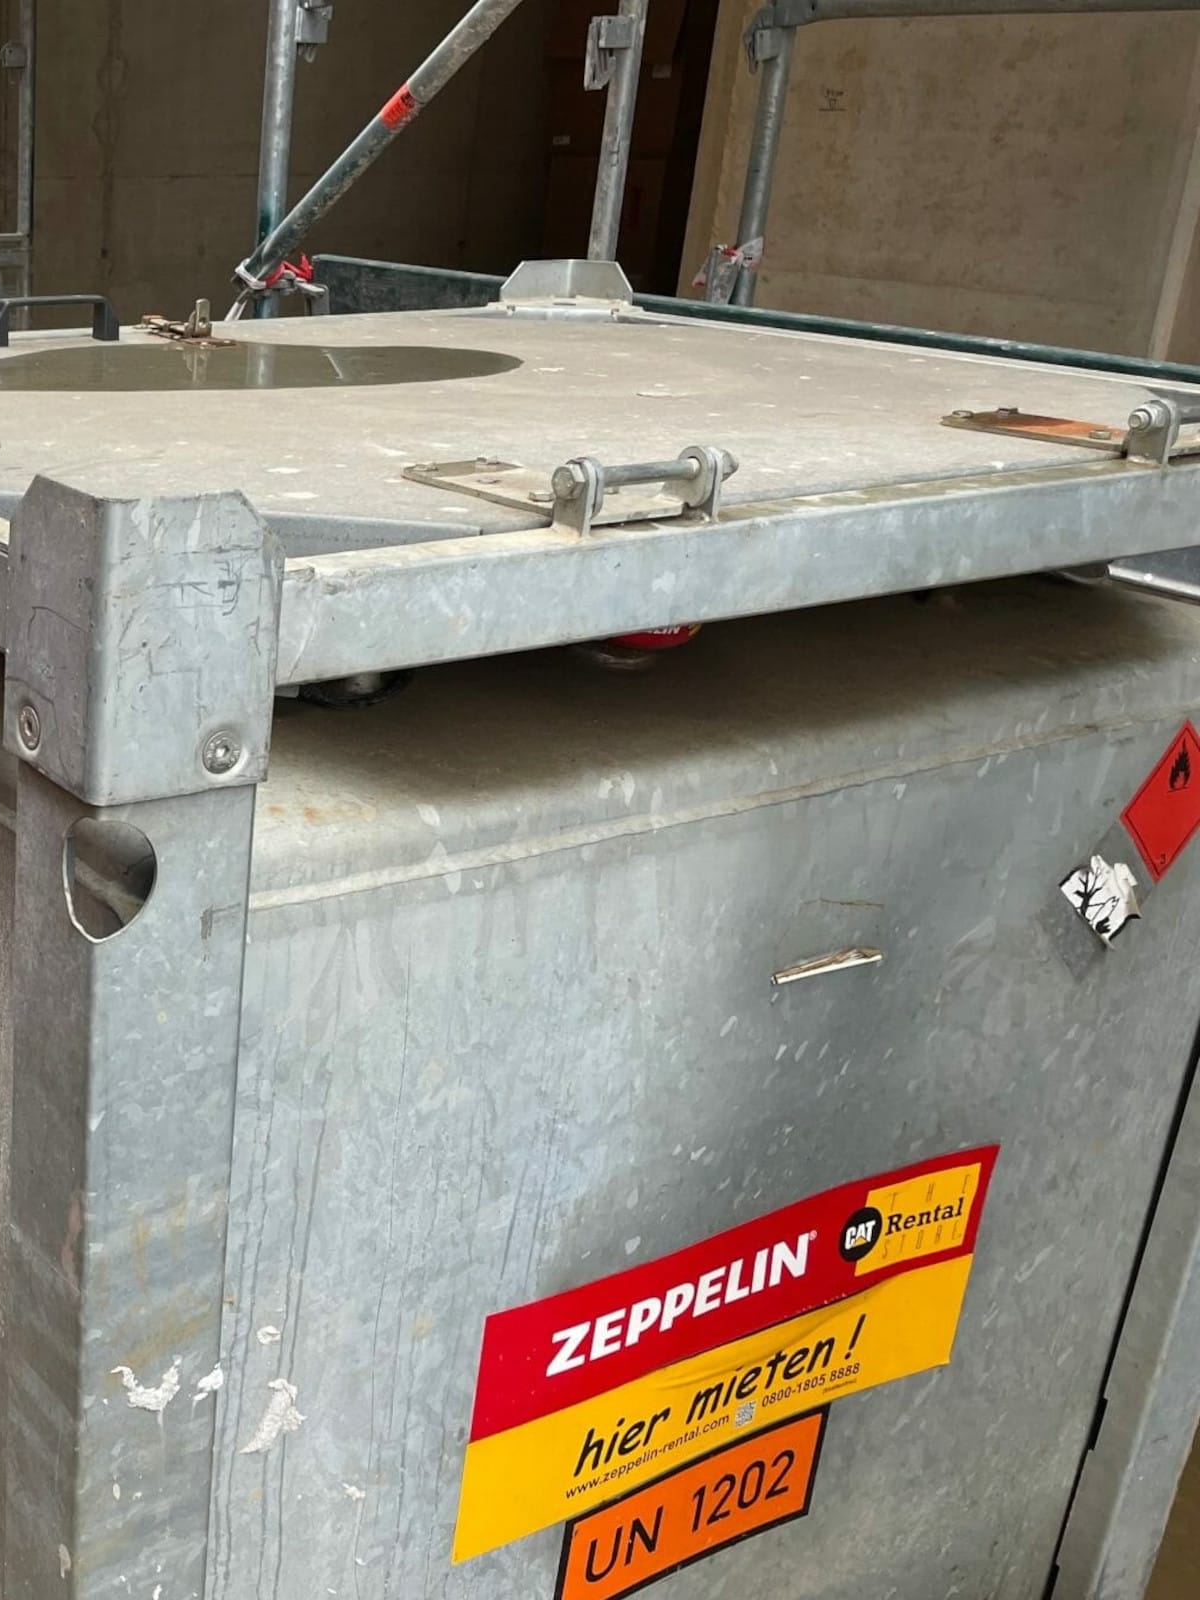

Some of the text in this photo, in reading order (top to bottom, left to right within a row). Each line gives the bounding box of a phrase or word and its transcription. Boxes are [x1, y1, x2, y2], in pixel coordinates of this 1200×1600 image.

[844, 1219, 877, 1250] CAT
[884, 1196, 965, 1236] Rental
[565, 1413, 731, 1500] www.zeppelin-rental.com
[761, 1373, 826, 1408] 0800-1805
[828, 1362, 860, 1383] 8888
[573, 1406, 672, 1478] hier
[685, 1334, 833, 1425] mieten
[584, 1448, 796, 1583] UN 1202
